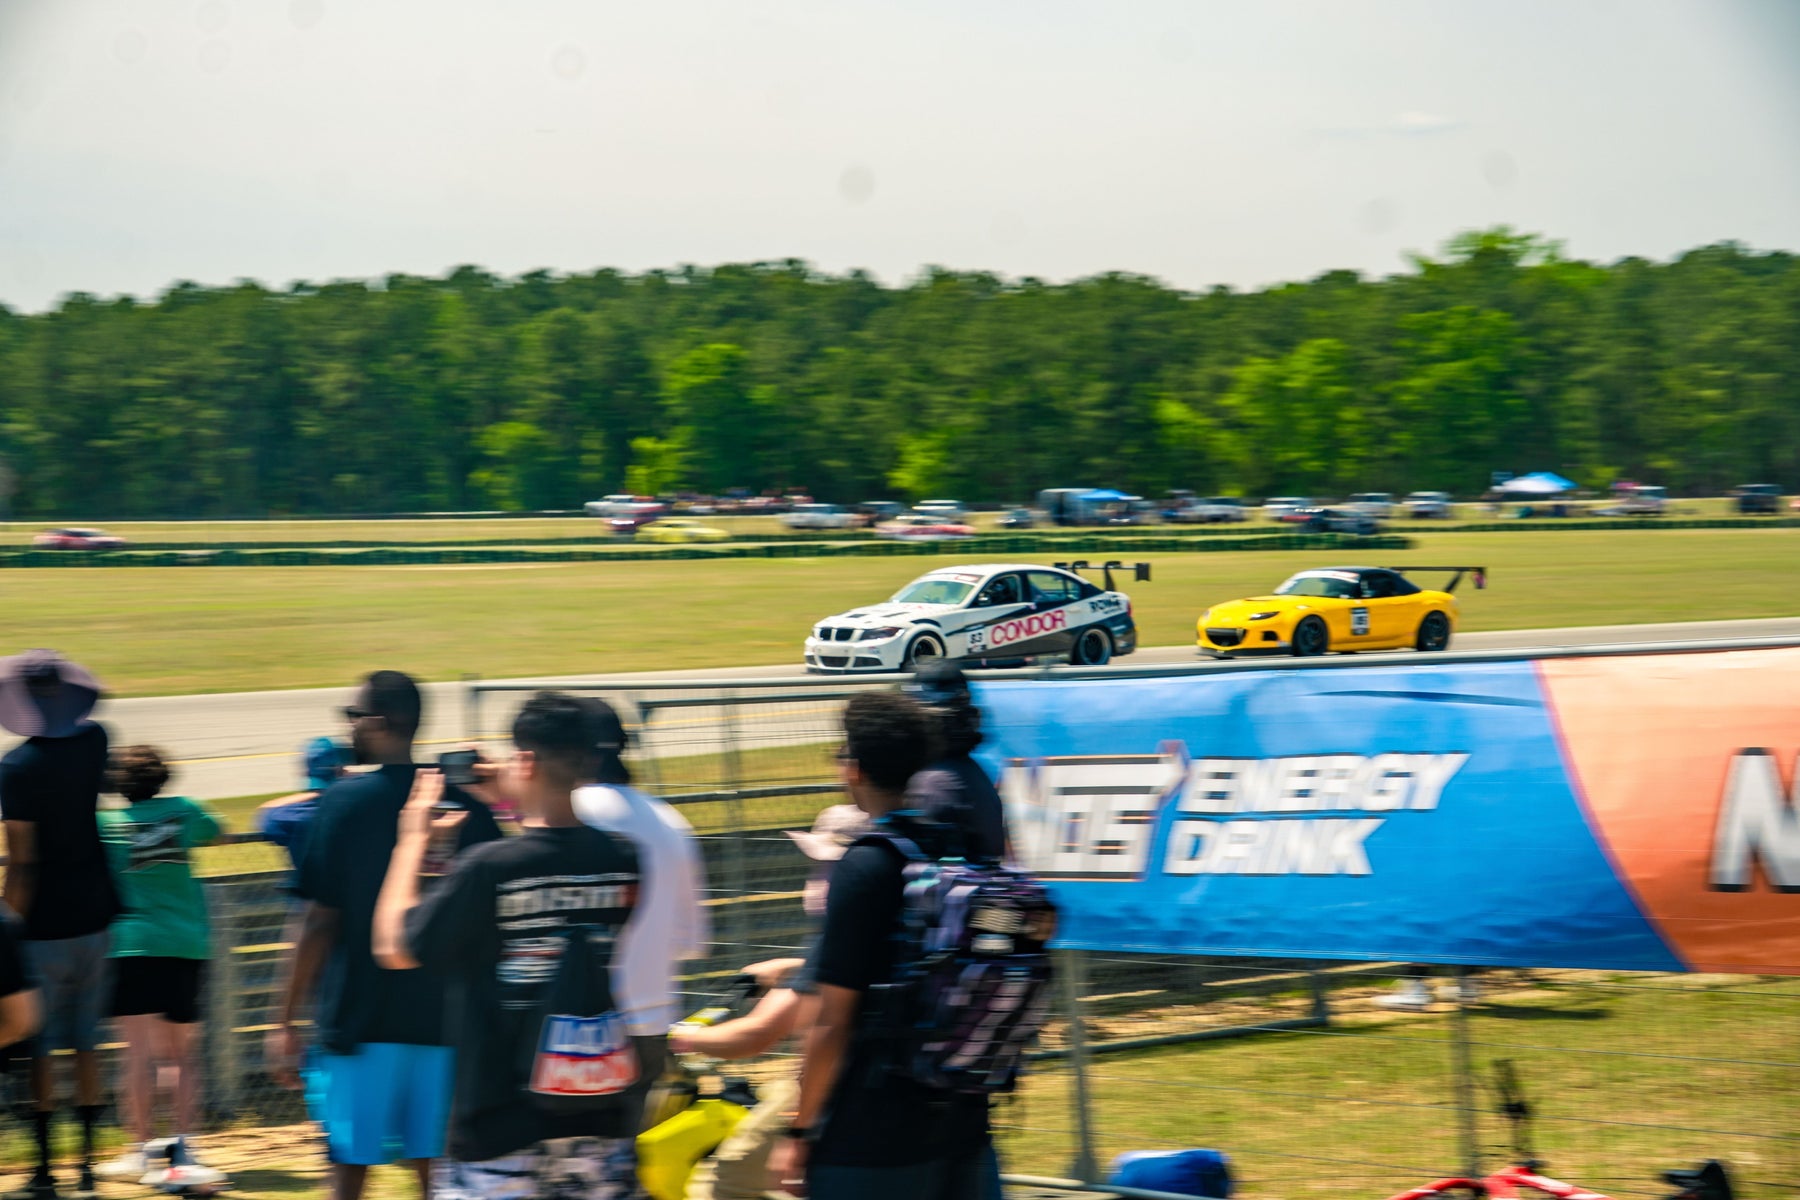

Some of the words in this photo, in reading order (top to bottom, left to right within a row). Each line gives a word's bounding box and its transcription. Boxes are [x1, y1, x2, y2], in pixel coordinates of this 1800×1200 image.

[991, 608, 1067, 645] CONDOR
[1177, 751, 1471, 813] ENERGY
[1163, 816, 1386, 876] DRINK
